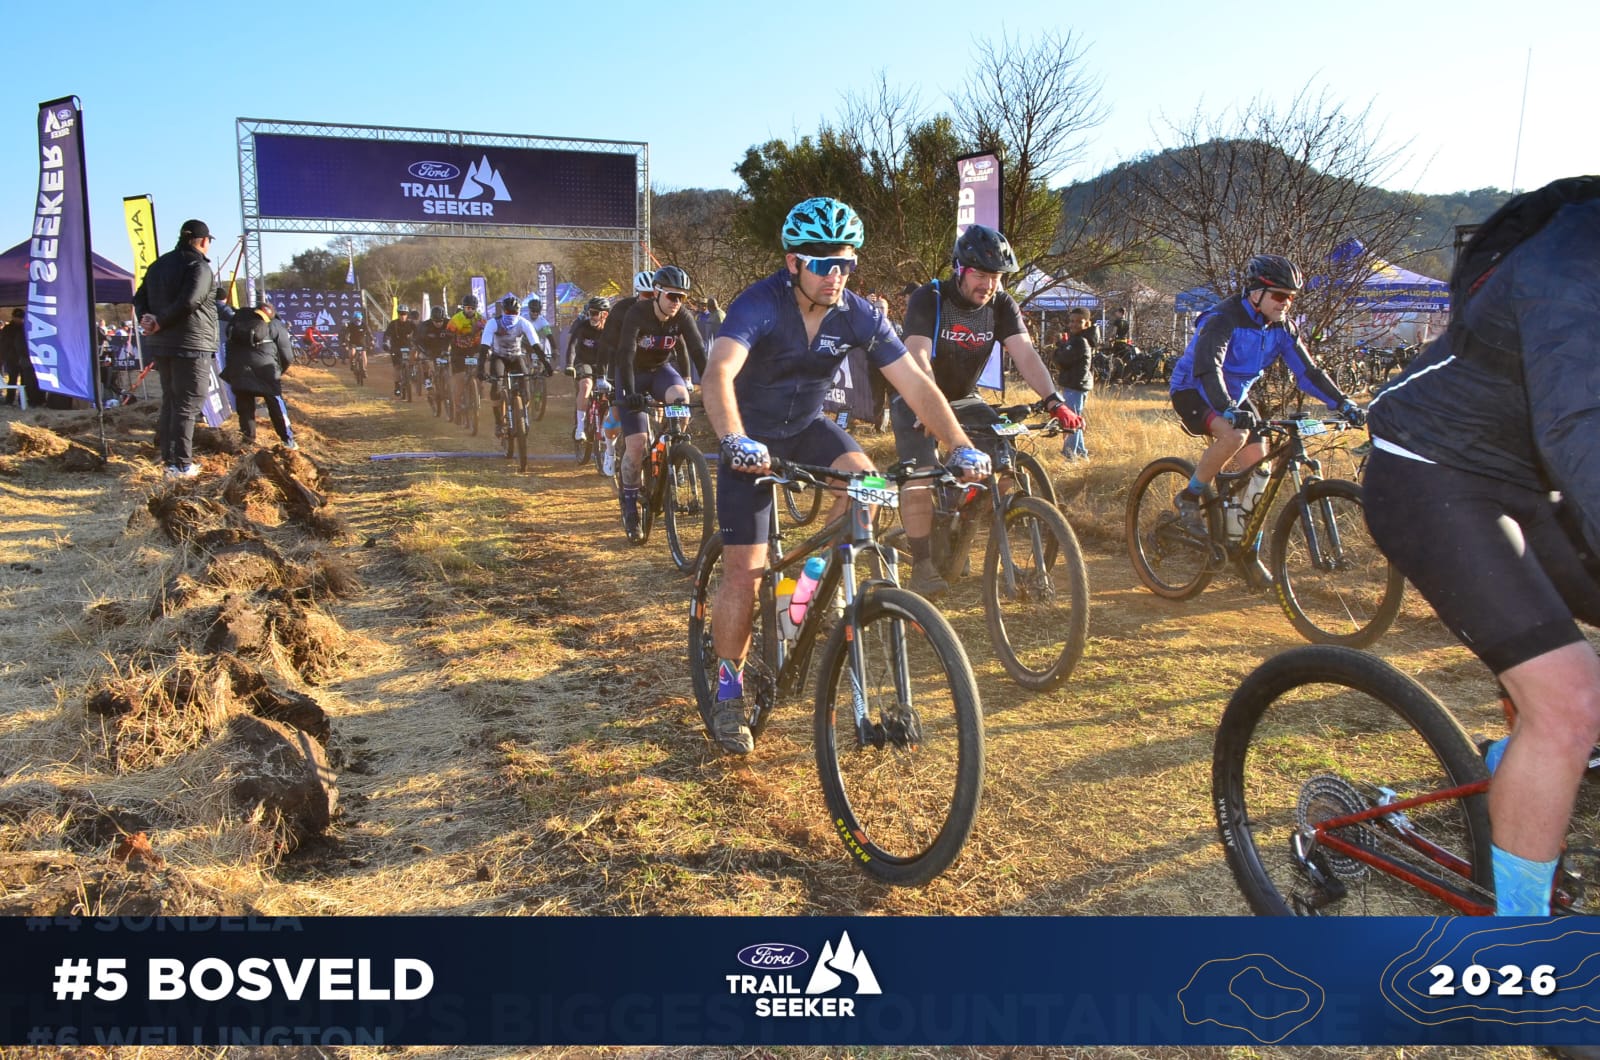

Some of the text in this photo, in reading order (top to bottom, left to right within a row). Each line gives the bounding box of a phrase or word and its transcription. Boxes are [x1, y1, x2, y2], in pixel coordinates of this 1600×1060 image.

[418, 163, 451, 178] Ford
[400, 182, 456, 199] TRAIL
[422, 200, 494, 217] SEEKER
[941, 329, 994, 342] LIZZARD
[836, 817, 872, 863] MAXXIS
